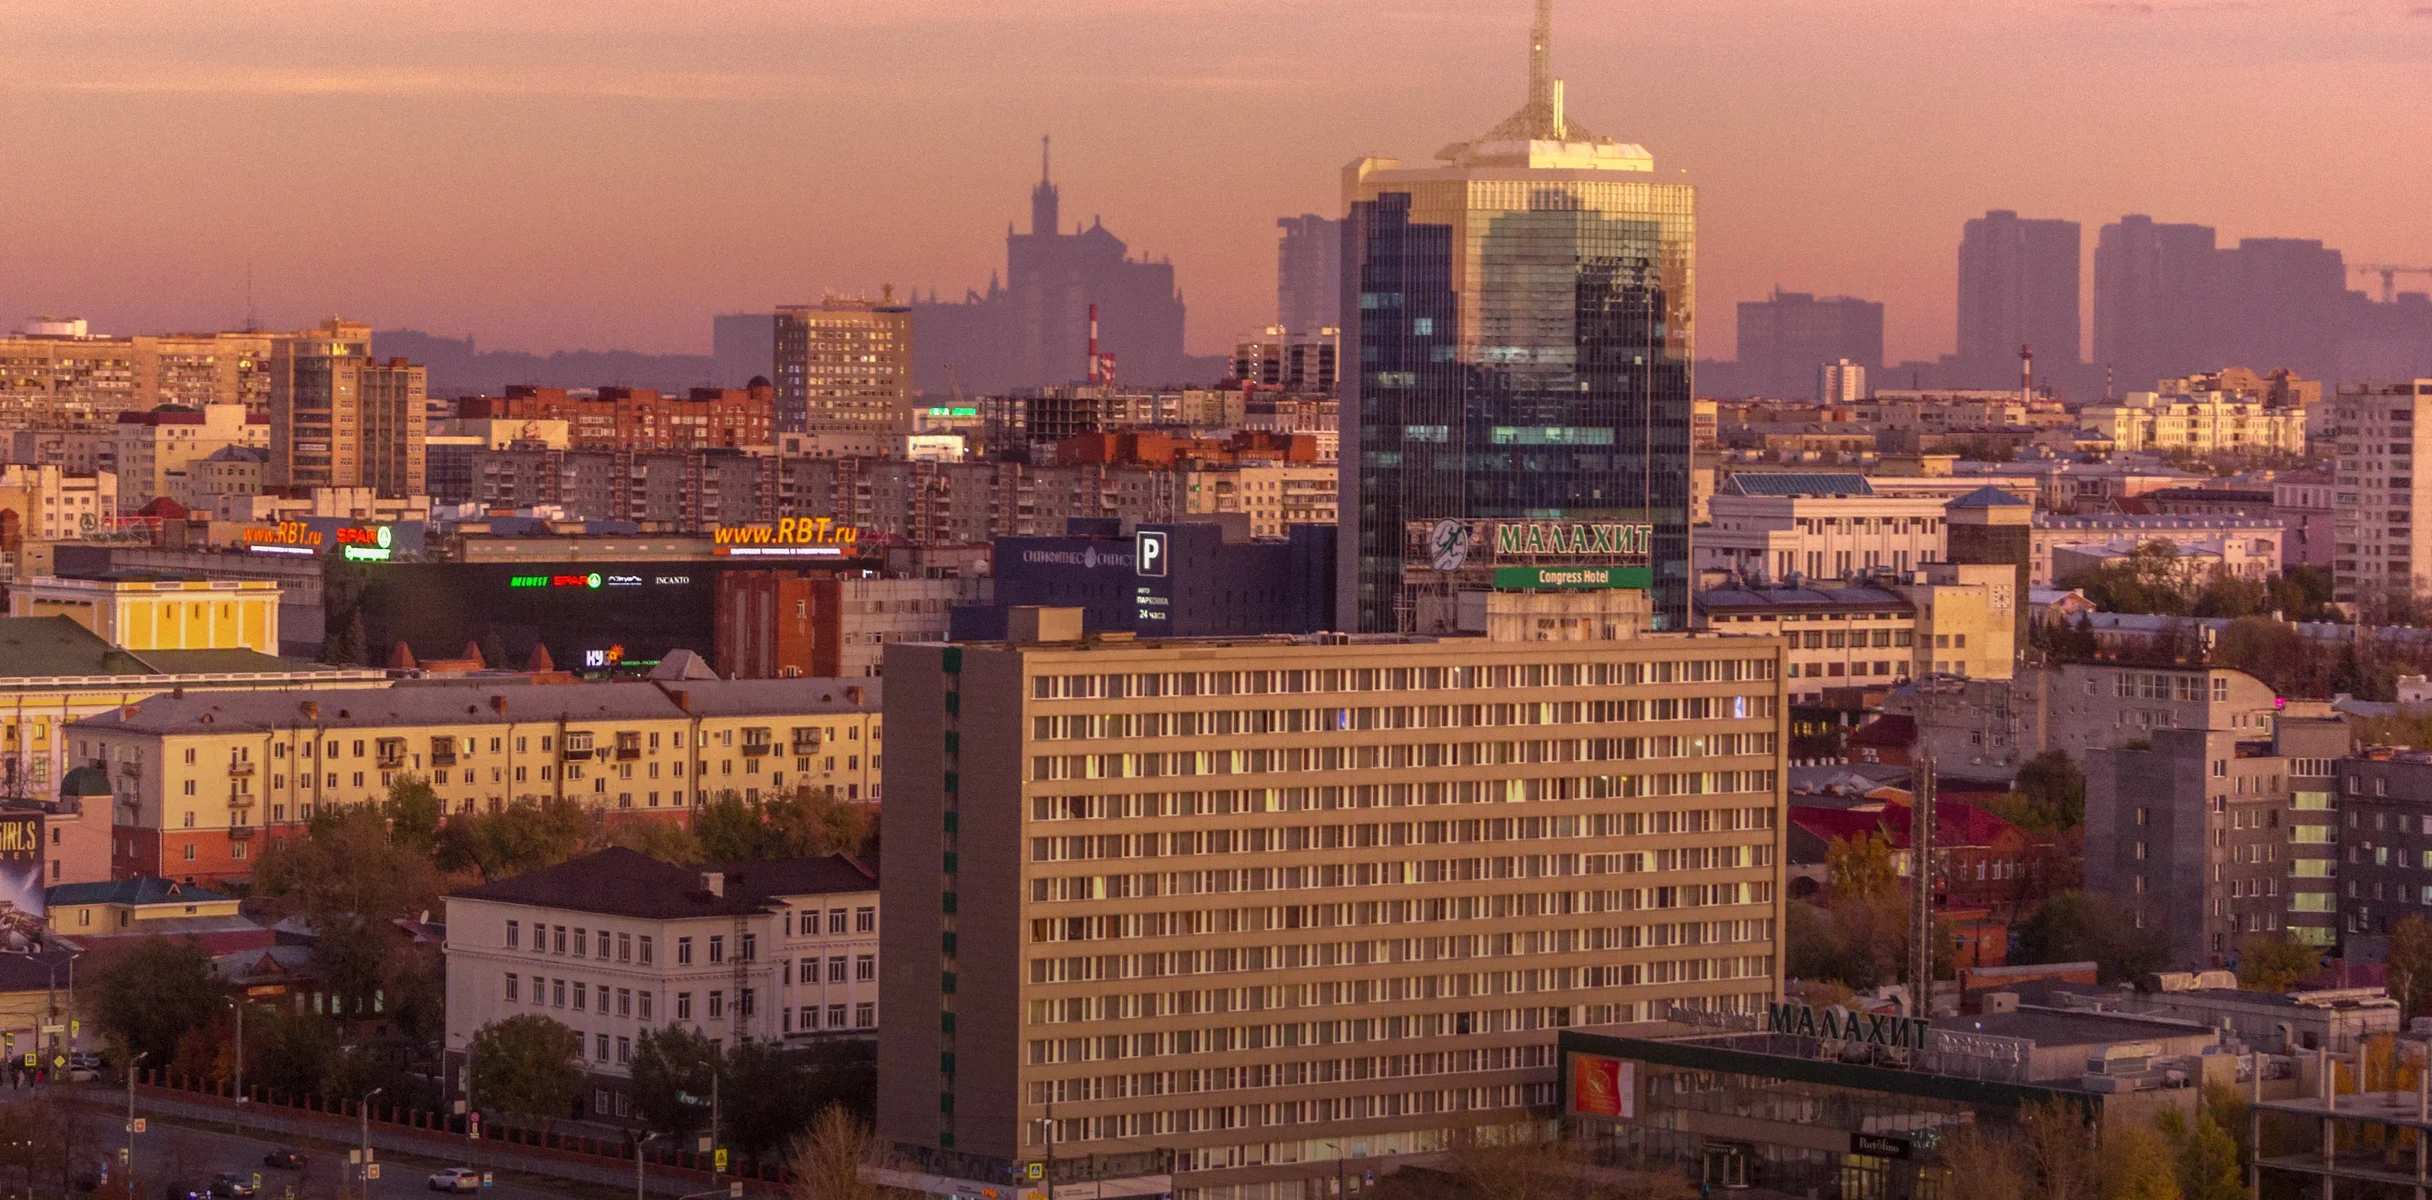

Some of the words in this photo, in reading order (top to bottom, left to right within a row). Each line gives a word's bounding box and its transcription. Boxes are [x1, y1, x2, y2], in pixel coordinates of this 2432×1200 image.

[243, 522, 323, 546] www.RBT.ru
[336, 527, 377, 544] SPAR
[714, 516, 857, 544] www.RBT.ru
[1497, 523, 1653, 554] МАЛАХИТ
[553, 575, 588, 587] SPAR
[656, 576, 690, 585] INCANTO
[1539, 569, 1582, 585] Congress
[1584, 570, 1609, 584] Hotel
[1139, 609, 1149, 619] 24
[1767, 1000, 1931, 1051] МАЛАХИТ
